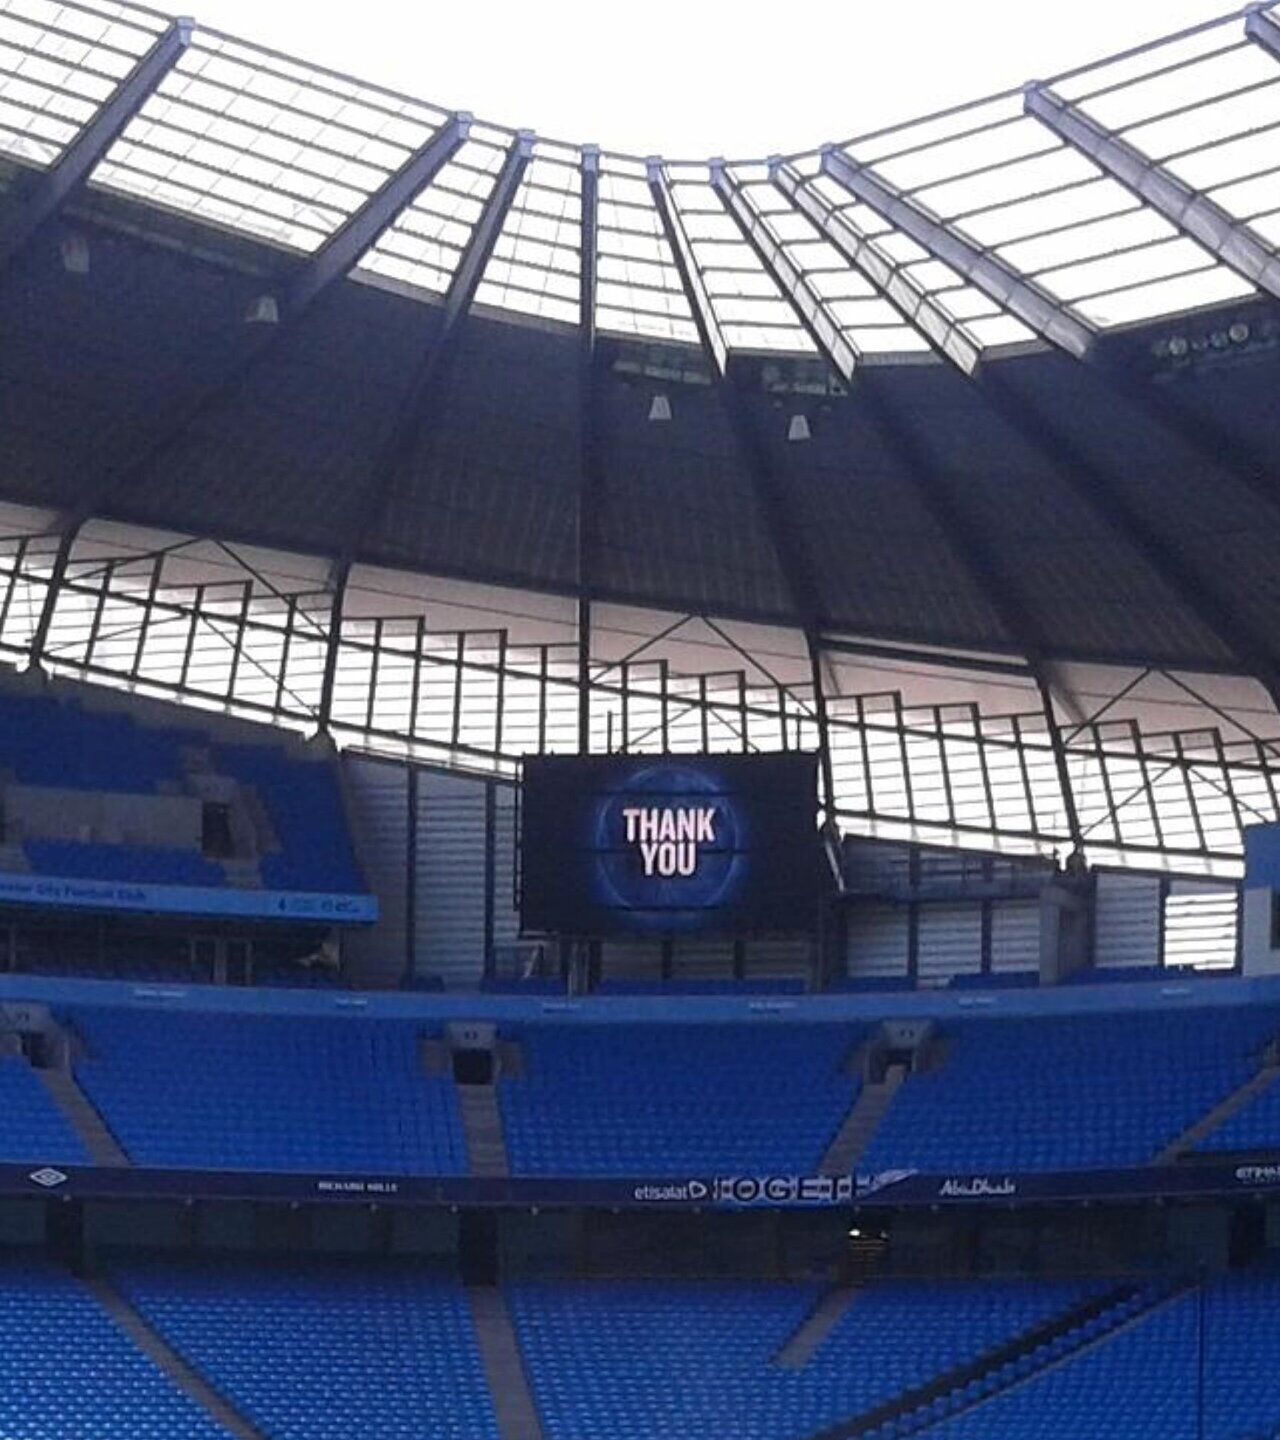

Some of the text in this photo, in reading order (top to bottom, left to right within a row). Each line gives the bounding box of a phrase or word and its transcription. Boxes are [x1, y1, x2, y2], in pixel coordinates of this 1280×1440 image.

[622, 807, 717, 842] THANK
[640, 842, 697, 877] YOU
[634, 1182, 689, 1201] etisalat
